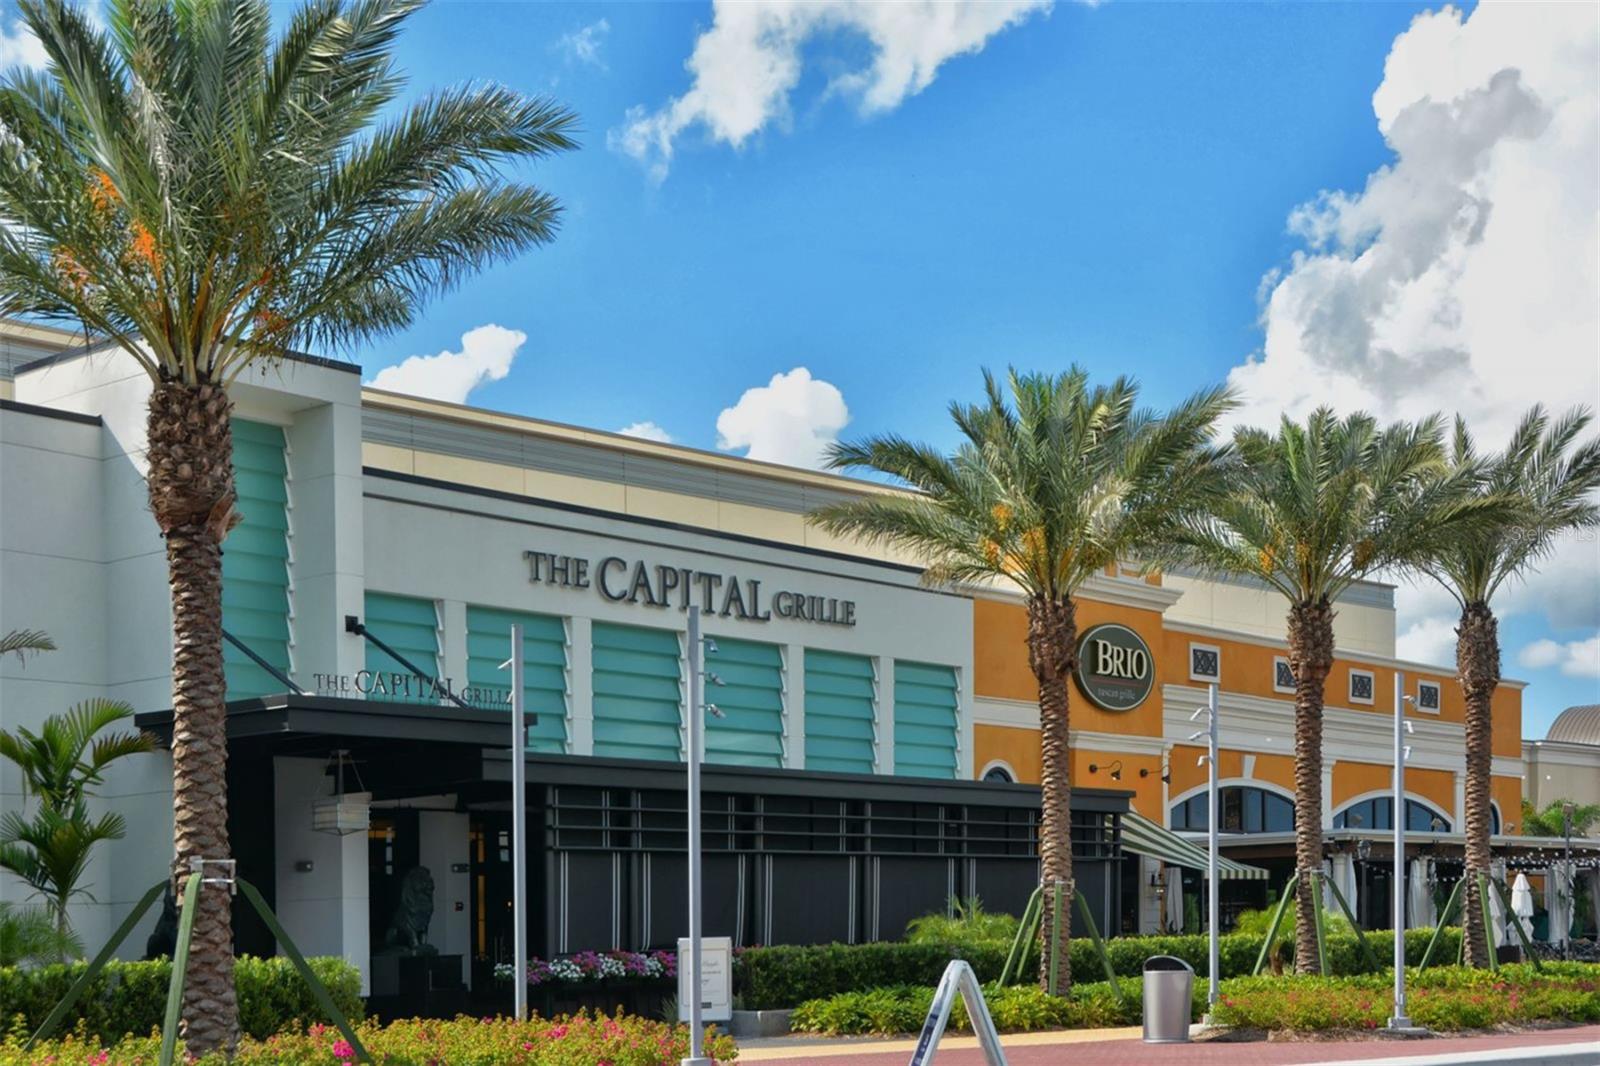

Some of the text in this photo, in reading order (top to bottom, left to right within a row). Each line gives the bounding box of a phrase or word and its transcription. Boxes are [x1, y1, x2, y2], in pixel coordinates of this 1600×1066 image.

[523, 550, 857, 627] THE CAPITAL GRILLE
[313, 672, 350, 692] THE
[354, 669, 460, 700] CAPITAL
